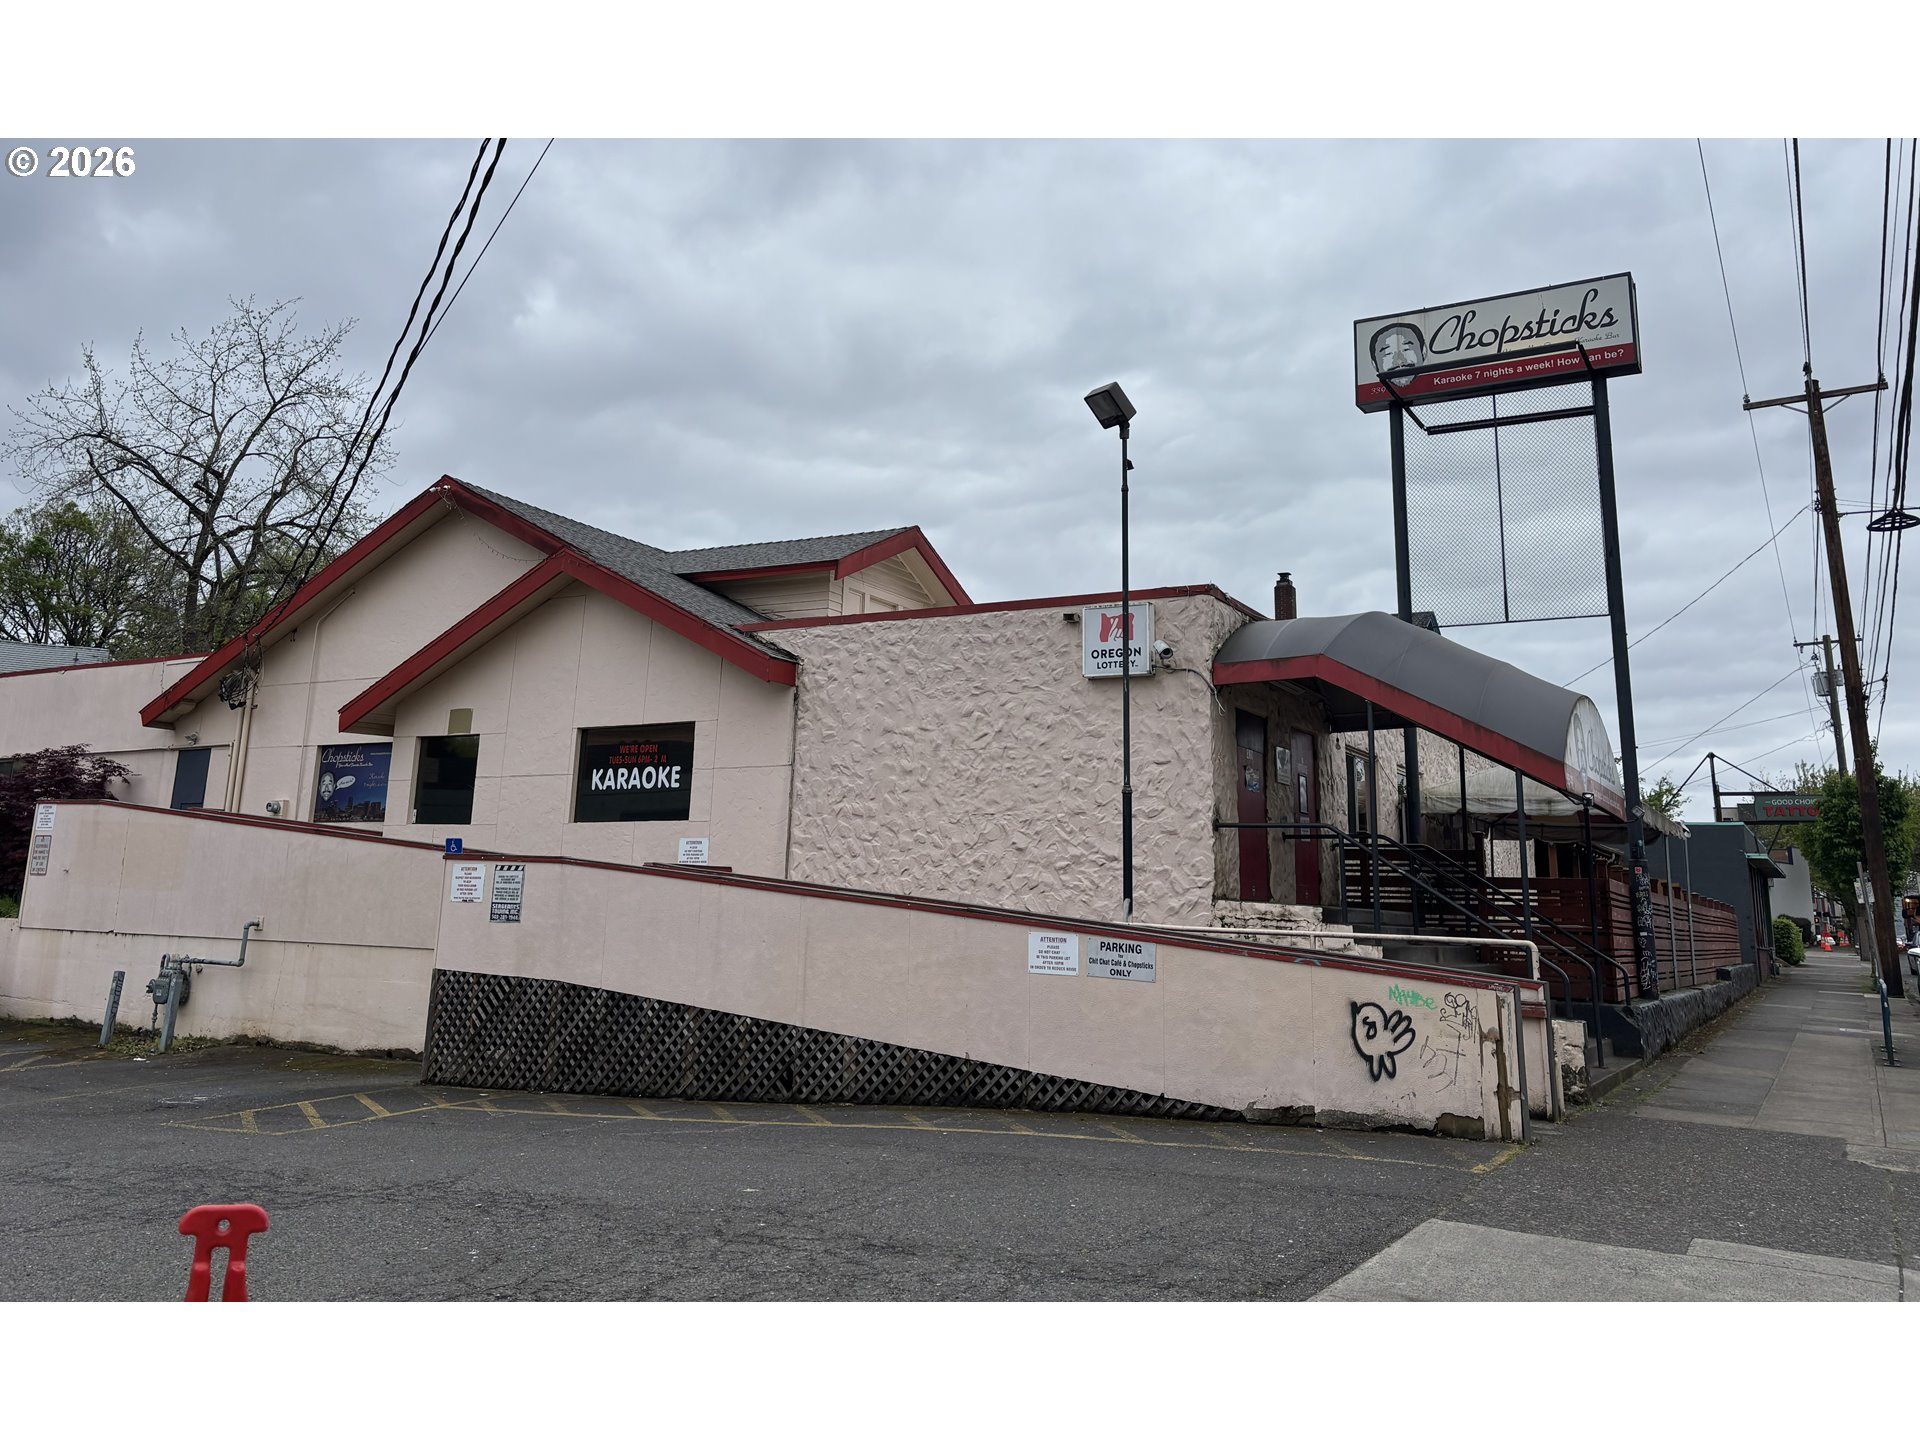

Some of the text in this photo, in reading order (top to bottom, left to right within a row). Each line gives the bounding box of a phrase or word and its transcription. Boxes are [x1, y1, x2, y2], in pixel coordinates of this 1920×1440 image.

[1428, 287, 1619, 355] Chopsticks
[1433, 374, 1473, 386] Karaoke
[1475, 370, 1481, 379] 7
[1483, 366, 1515, 382] nights
[1525, 360, 1554, 371] week!
[1557, 356, 1581, 367] How
[1588, 353, 1602, 362] an
[1605, 348, 1625, 359] be?
[1097, 660, 1136, 669] LOTTEY
[639, 743, 658, 753] OPEN
[321, 746, 365, 768] Chopsticks
[591, 766, 681, 791] KARAOKE
[1763, 805, 1820, 817] TATTO
[1099, 941, 1142, 954] PARKING
[1099, 958, 1110, 966] Chat
[1128, 960, 1154, 970] Chopsticks
[1109, 968, 1132, 977] ONLY
